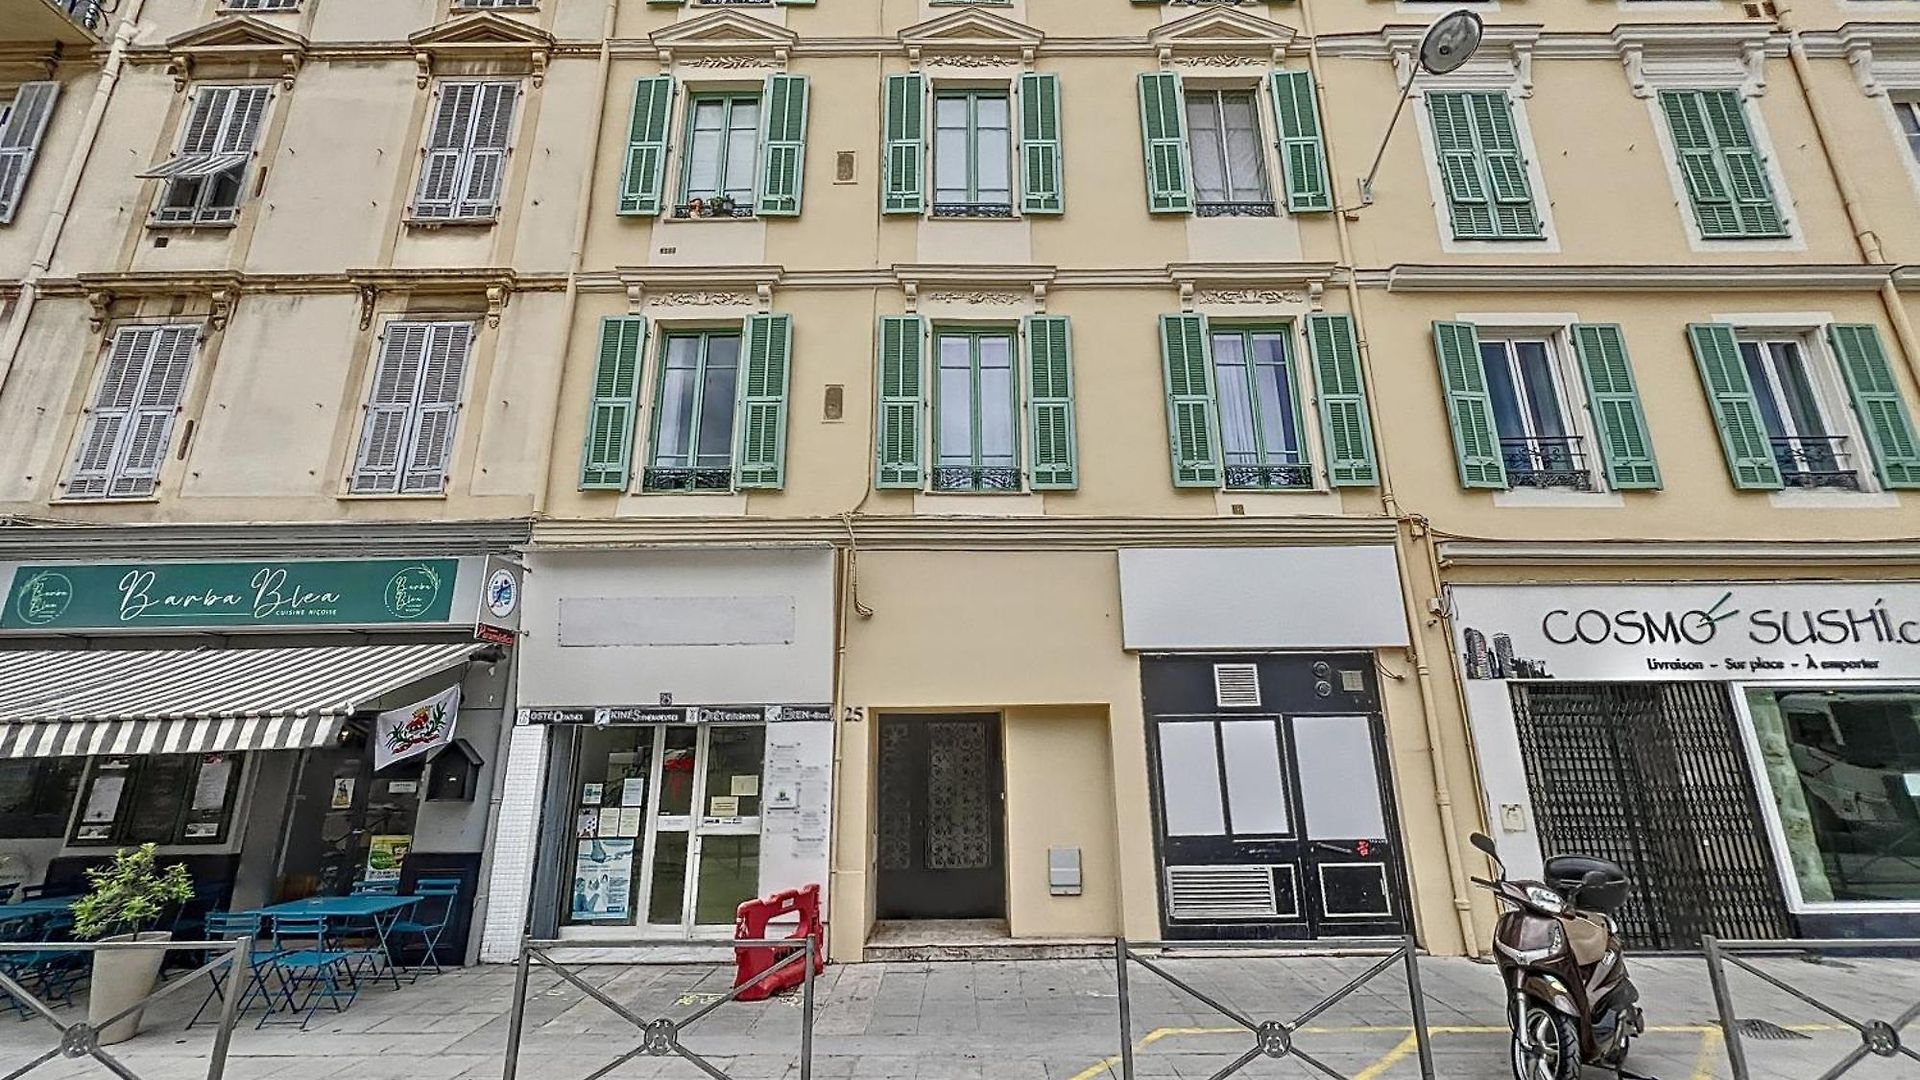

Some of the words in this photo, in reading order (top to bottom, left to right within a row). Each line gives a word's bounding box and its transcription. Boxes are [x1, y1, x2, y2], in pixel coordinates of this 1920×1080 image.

[118, 569, 241, 621] Barba
[251, 567, 340, 619] Blea
[1543, 609, 1717, 645] COSMO
[1647, 657, 1704, 671] Livraison
[1724, 657, 1746, 671] Sur
[1749, 656, 1785, 672] place
[844, 706, 863, 722] 25
